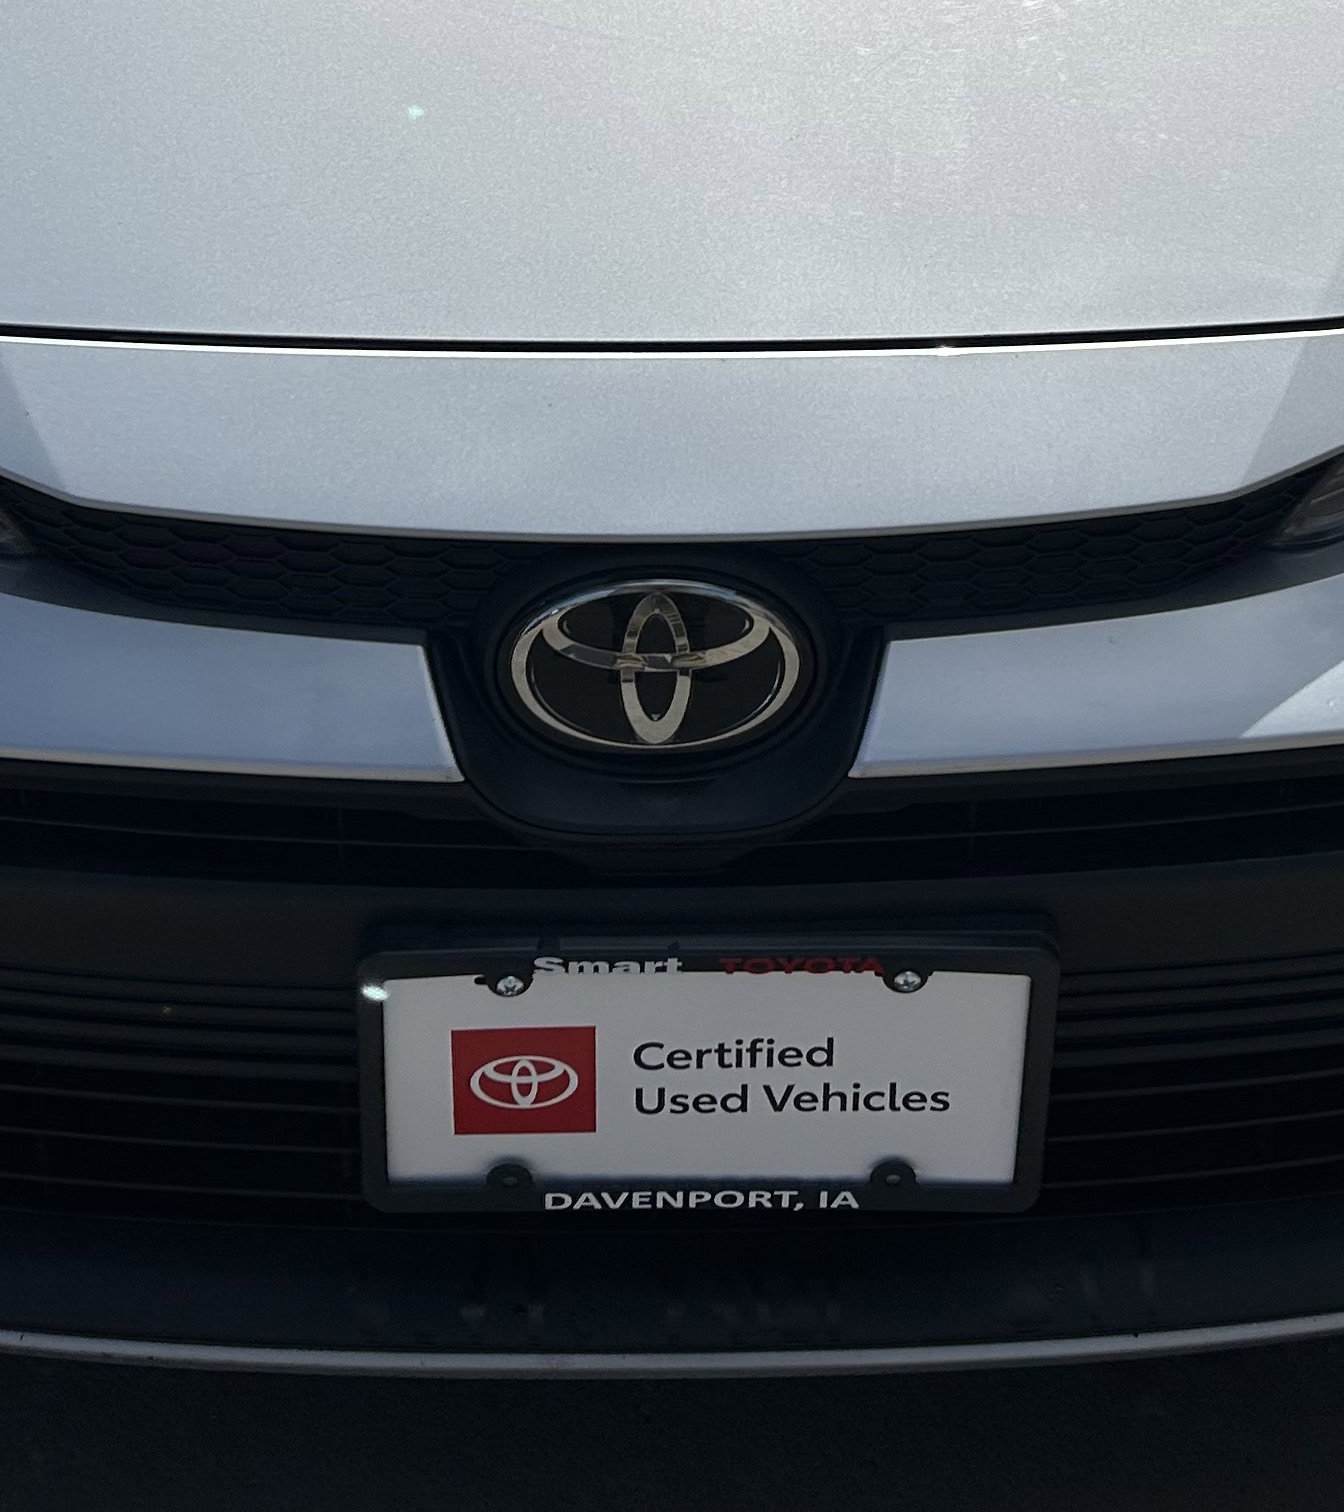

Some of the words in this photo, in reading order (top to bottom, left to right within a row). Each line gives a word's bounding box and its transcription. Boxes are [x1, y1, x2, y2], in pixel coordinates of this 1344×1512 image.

[533, 956, 684, 975] Smart
[718, 957, 887, 975] TOYOTA
[632, 1036, 836, 1071] Certified
[633, 1084, 749, 1115] Used
[762, 1082, 951, 1113] Vehicles
[543, 1188, 805, 1213] DAVENPORT,
[817, 1189, 860, 1210] IA
